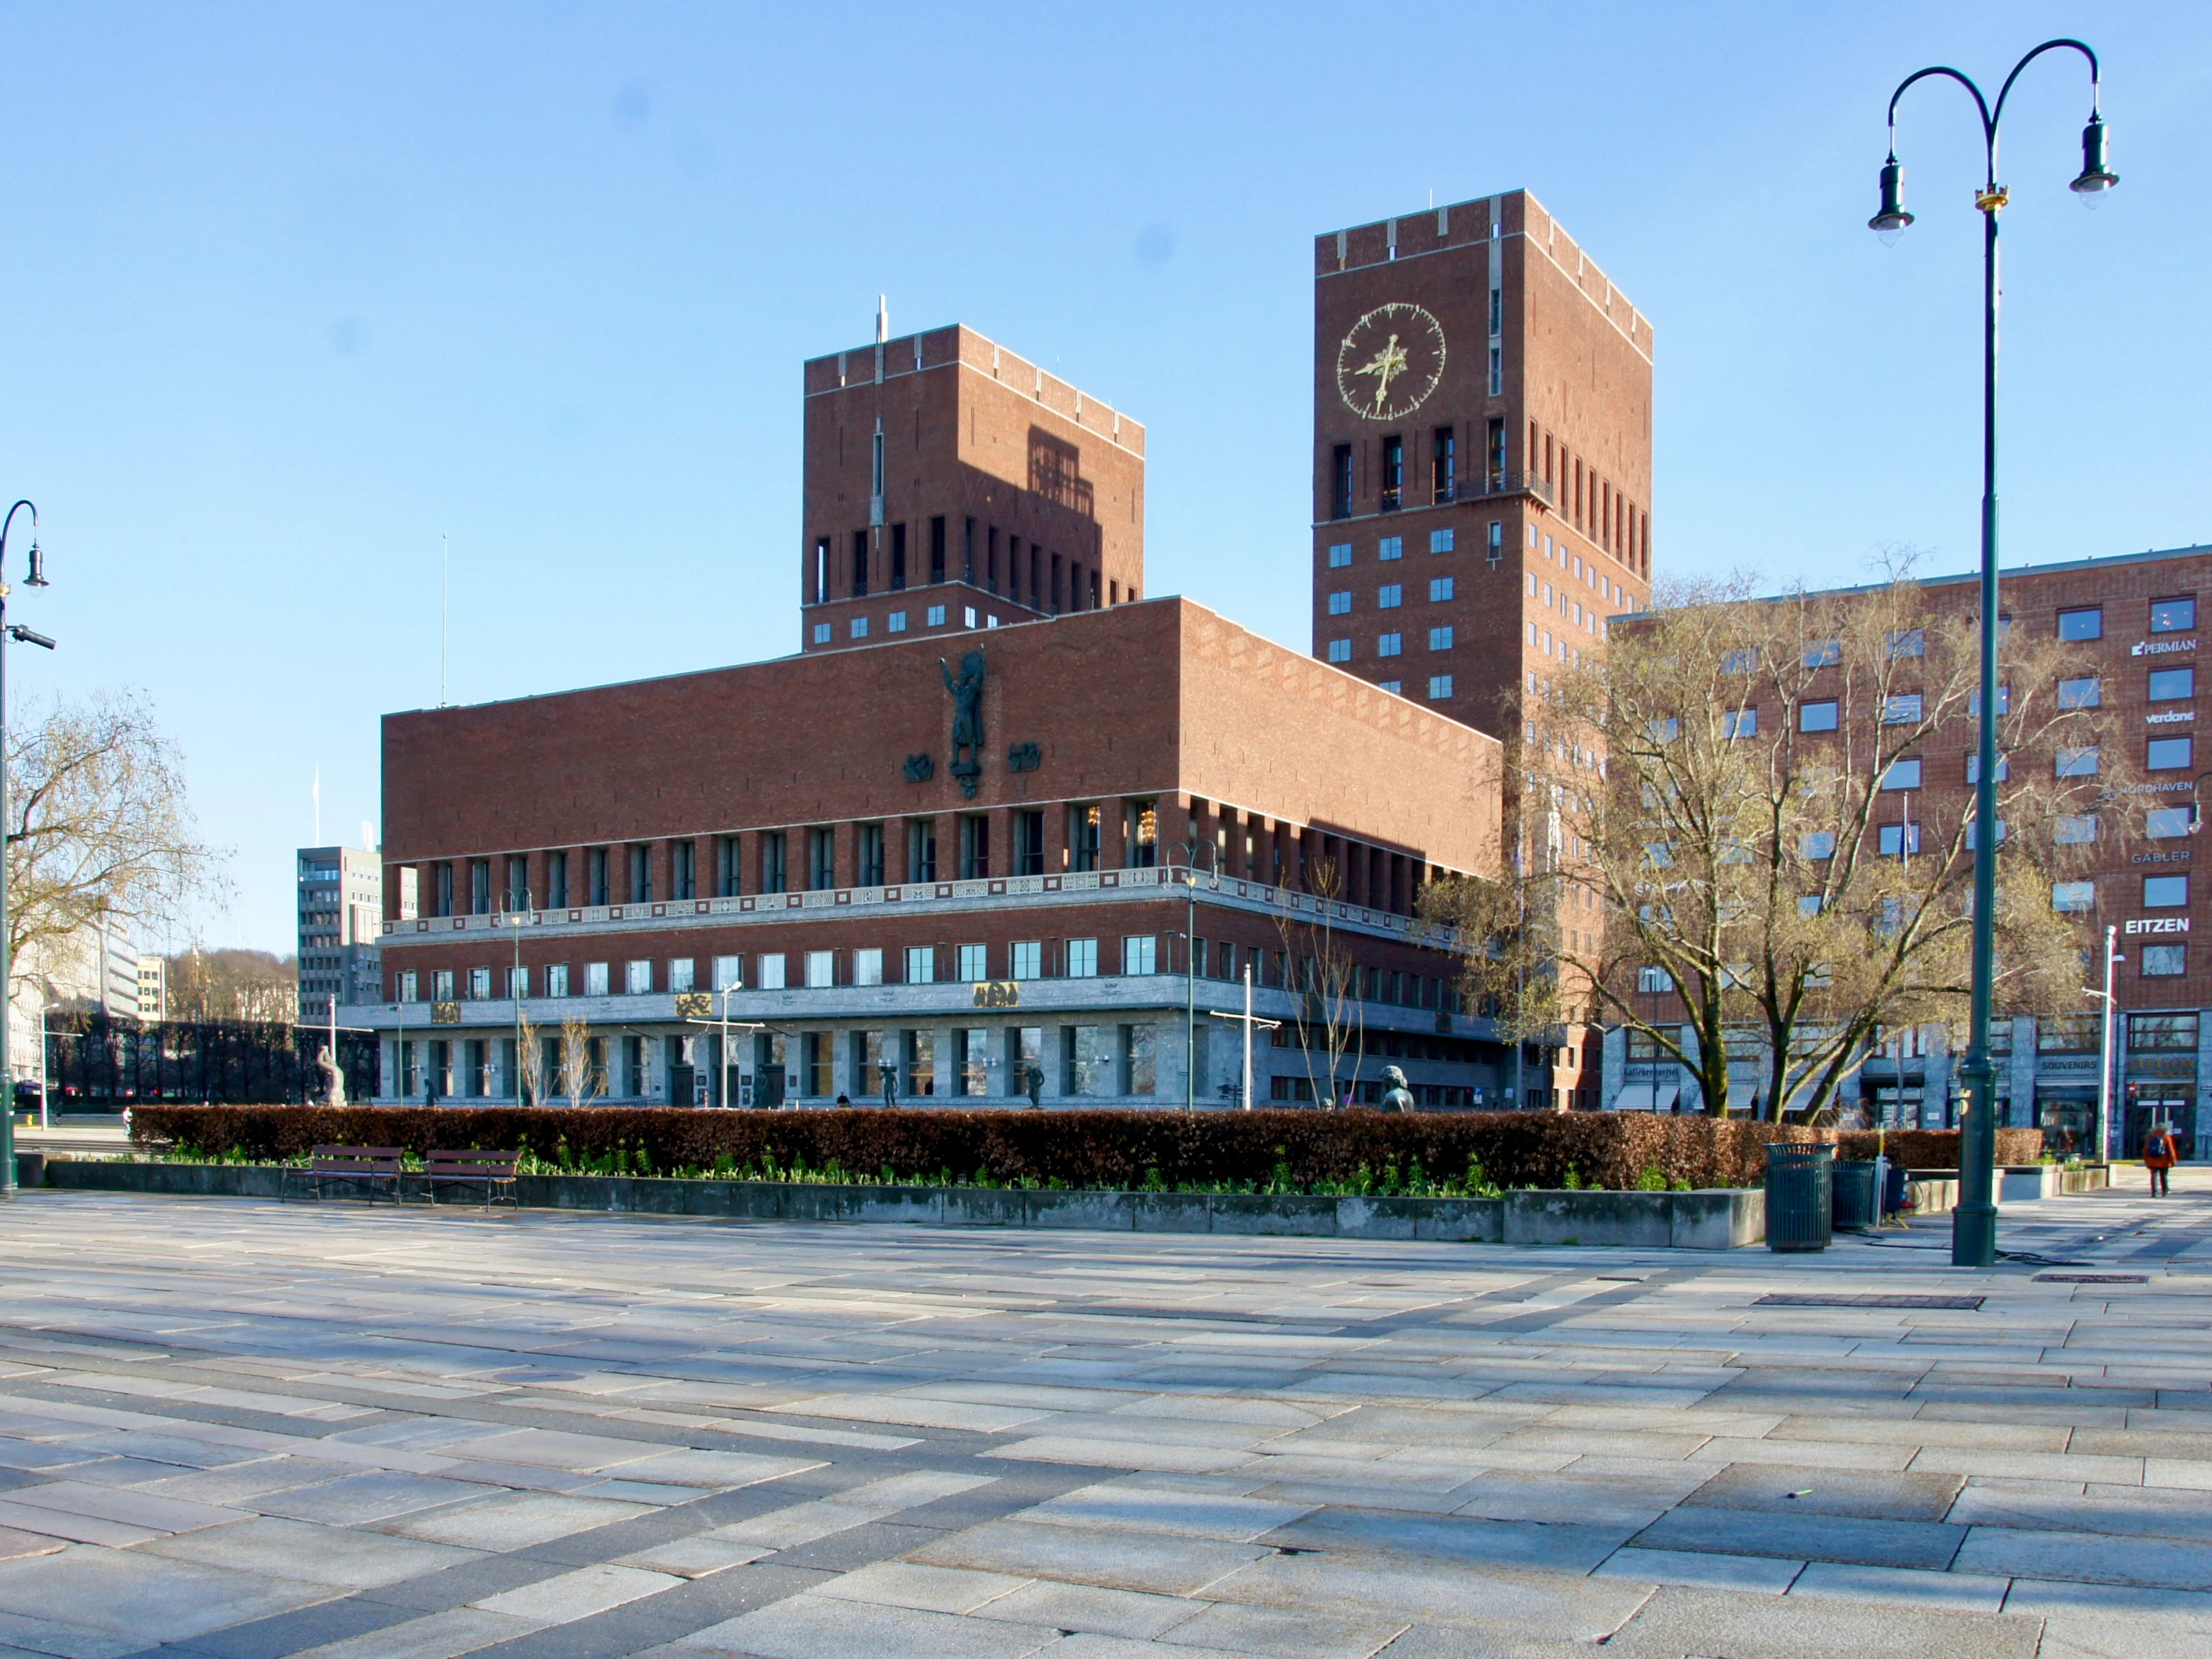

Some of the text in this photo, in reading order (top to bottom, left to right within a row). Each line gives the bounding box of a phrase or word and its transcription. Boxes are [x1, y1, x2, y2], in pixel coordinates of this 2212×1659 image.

[1387, 303, 1396, 311] 12
[2144, 639, 2196, 654] PERMIAN
[2146, 710, 2195, 724] verdane
[2119, 782, 2193, 793] NORDHAVEN
[2132, 851, 2190, 863] GABLER
[2125, 918, 2189, 934] EITZEN
[2042, 1061, 2096, 1070] SOUVENIRS
[2129, 1058, 2194, 1070] STETSON
[1624, 1067, 1679, 1078] Kaffebreneriet
